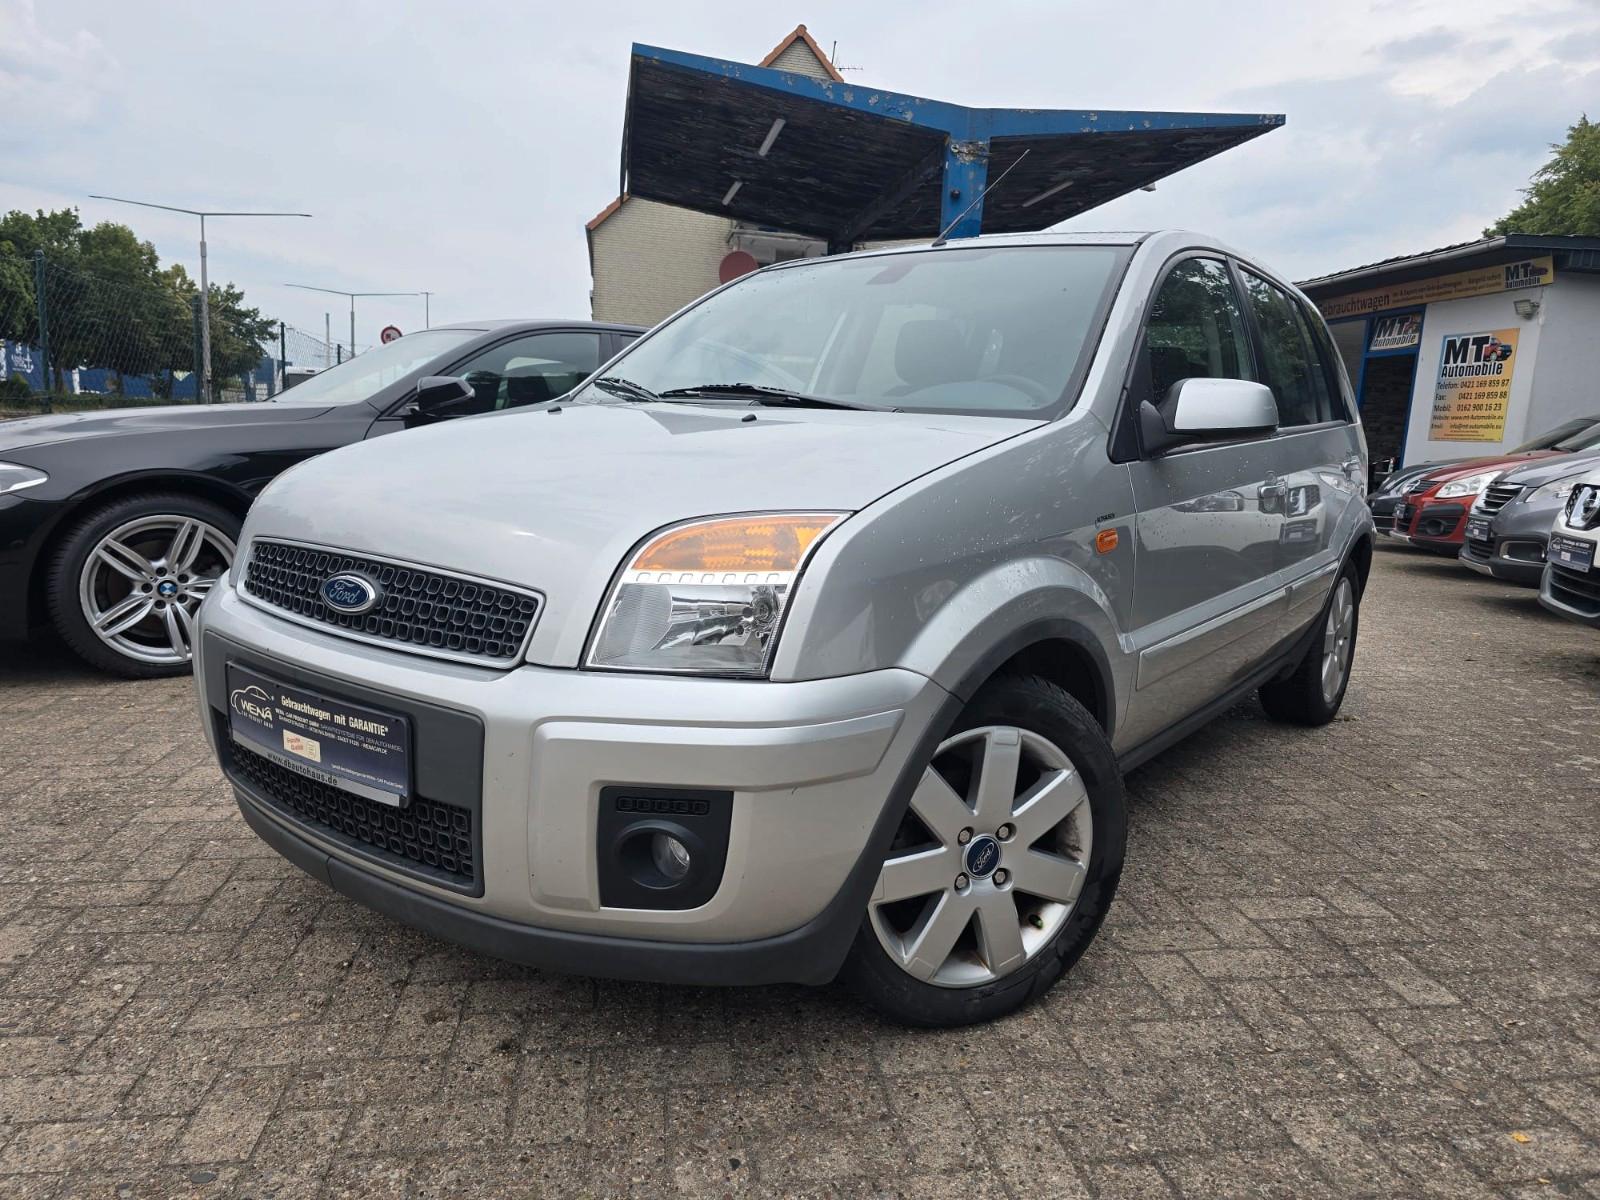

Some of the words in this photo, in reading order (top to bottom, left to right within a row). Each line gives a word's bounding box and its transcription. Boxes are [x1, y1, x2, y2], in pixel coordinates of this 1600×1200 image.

[1376, 316, 1411, 338] MT
[1444, 336, 1490, 364] MT
[1441, 362, 1503, 378] Automobile
[1437, 381, 1459, 389] Telefon:
[1476, 380, 1487, 388] 169
[1458, 392, 1472, 400] 0421
[330, 580, 361, 604] Ford
[281, 695, 331, 721] Gebrauchtwagen
[334, 714, 346, 726] mit
